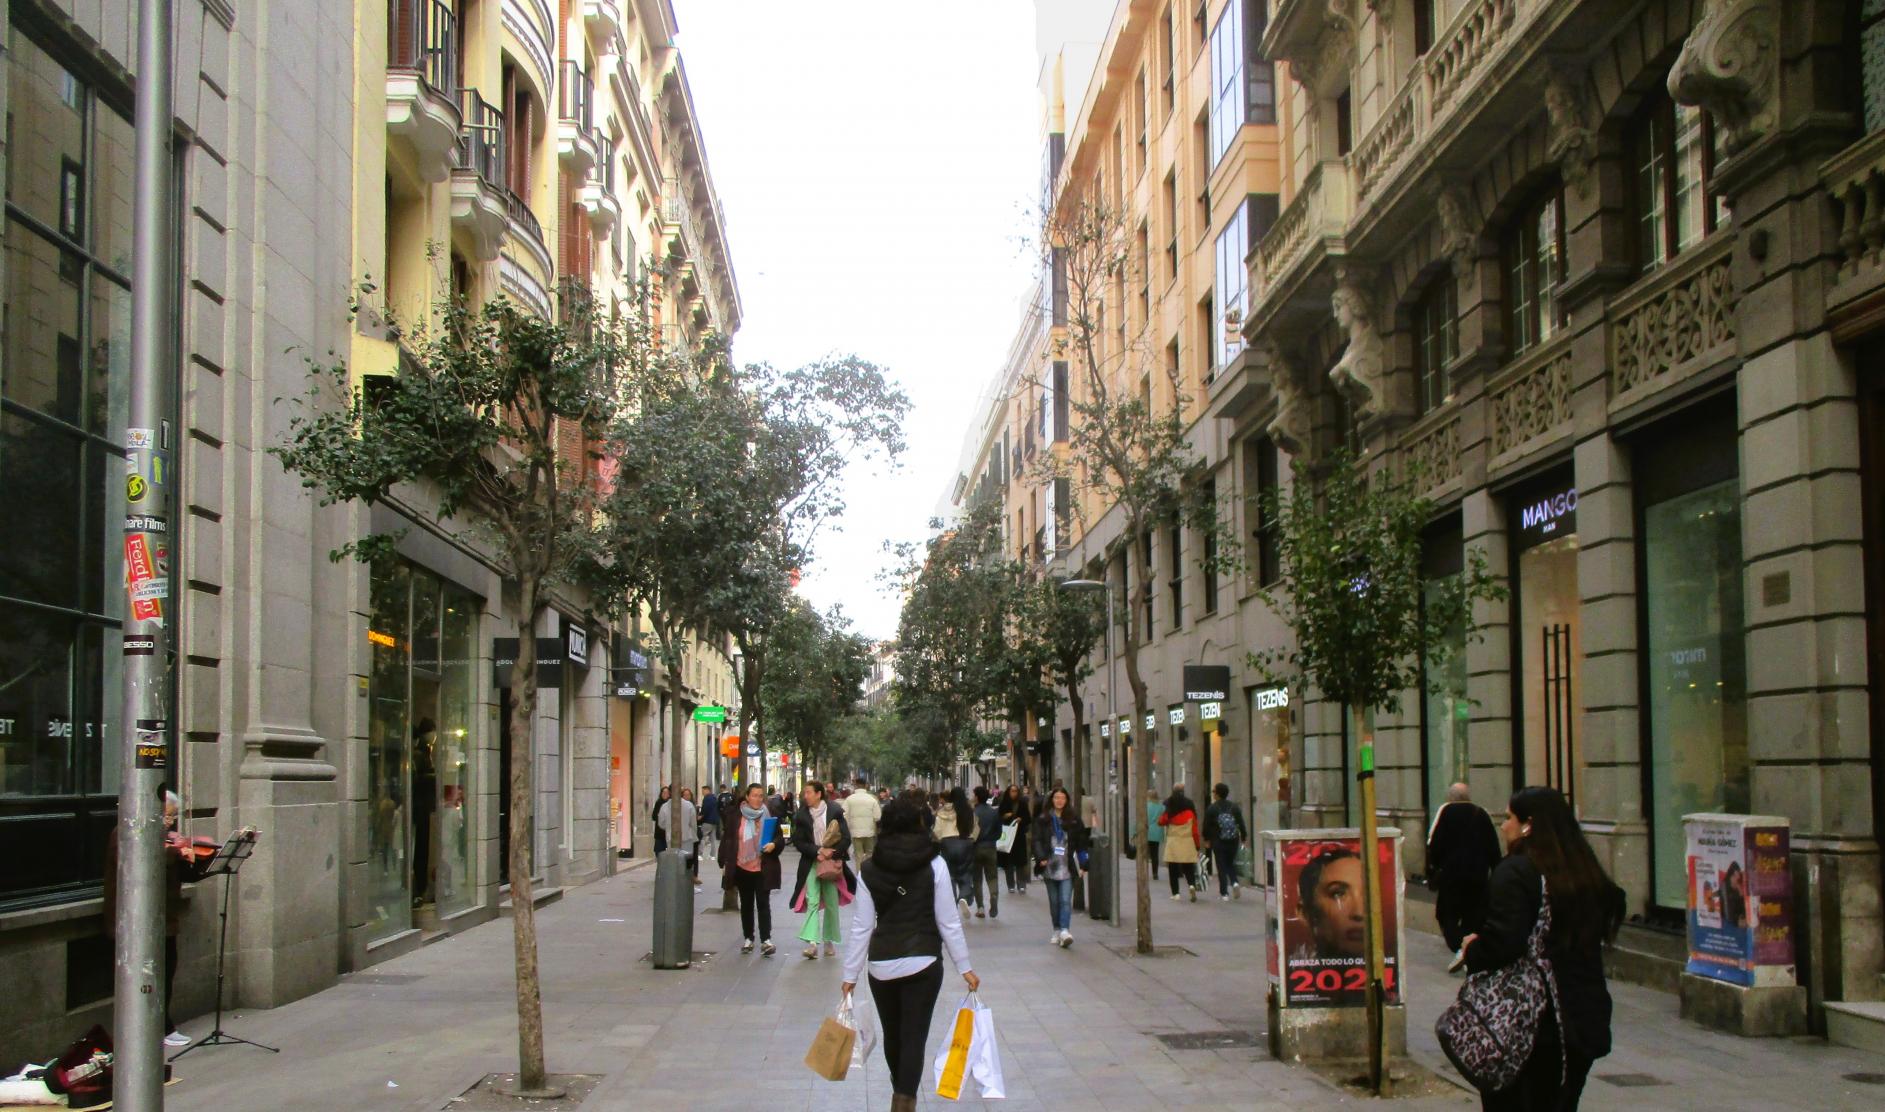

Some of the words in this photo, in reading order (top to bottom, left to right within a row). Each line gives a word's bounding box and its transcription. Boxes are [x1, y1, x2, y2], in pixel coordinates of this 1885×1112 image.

[1523, 488, 1577, 530] MANGO
[1186, 690, 1225, 699] TEZENIS
[1257, 687, 1289, 711] TEZENIS
[1200, 702, 1221, 720] TEZEN
[1289, 959, 1320, 967] ABRAZA
[1344, 958, 1354, 966] LO
